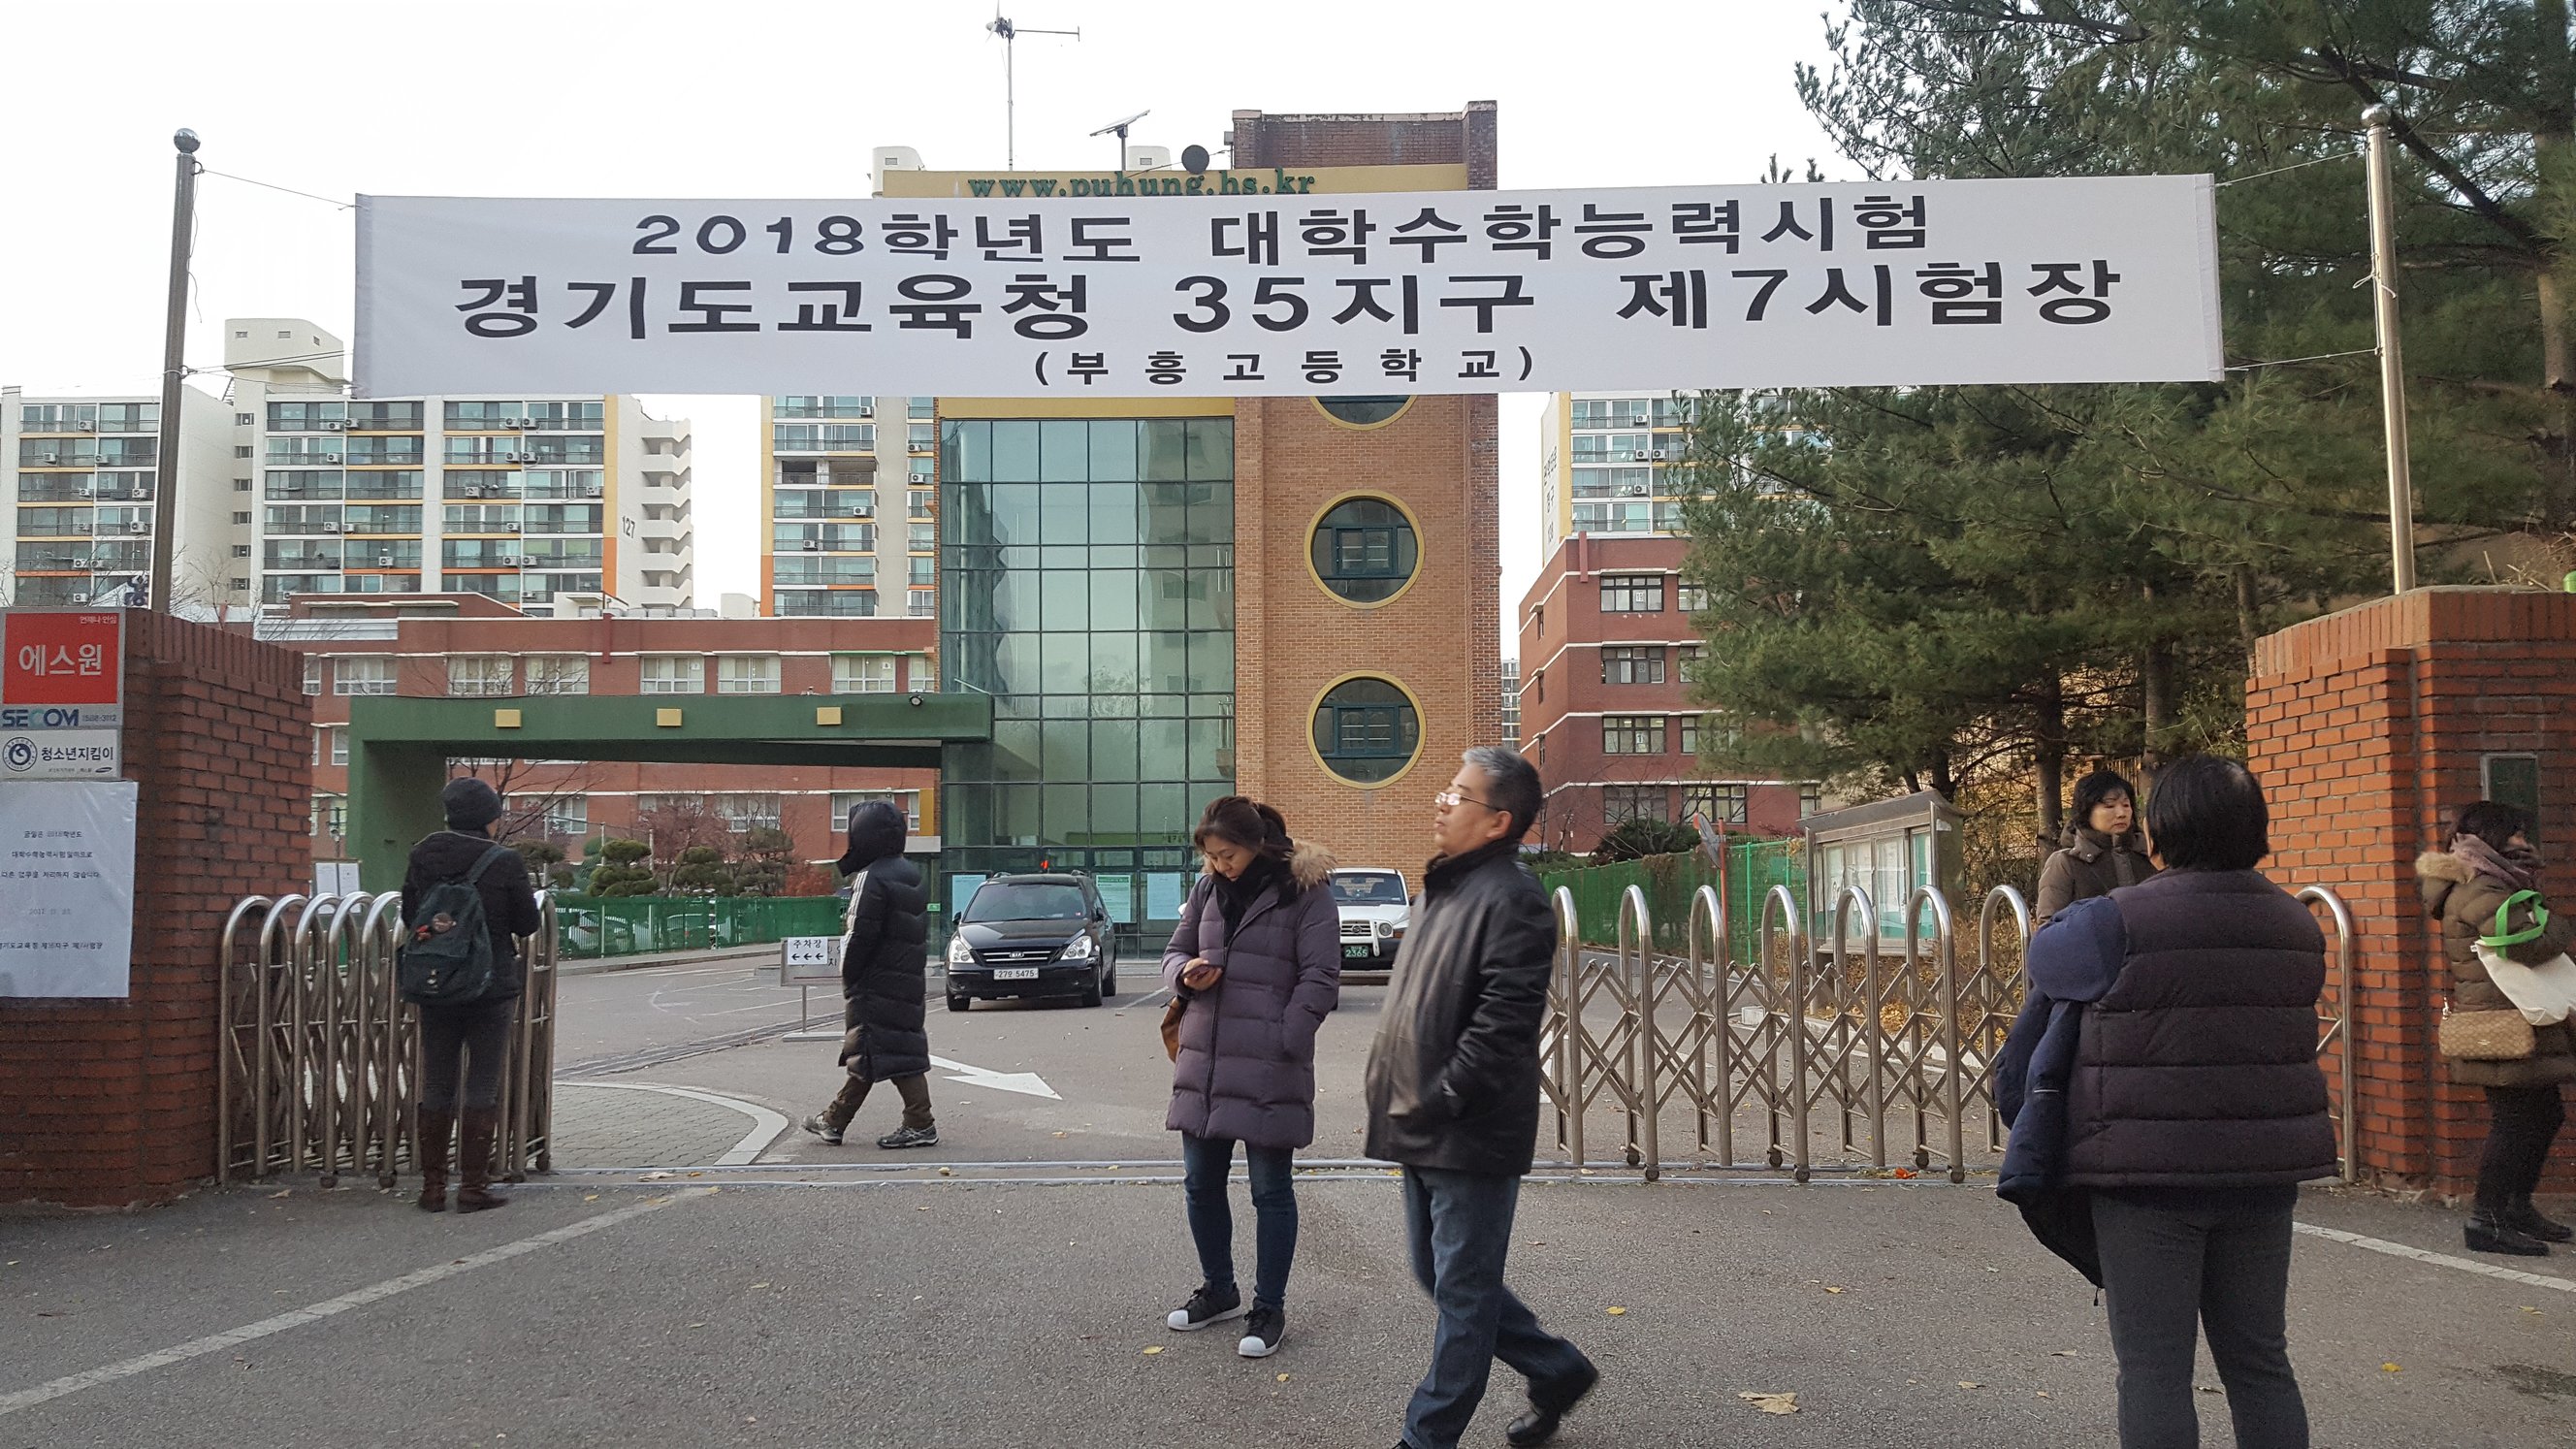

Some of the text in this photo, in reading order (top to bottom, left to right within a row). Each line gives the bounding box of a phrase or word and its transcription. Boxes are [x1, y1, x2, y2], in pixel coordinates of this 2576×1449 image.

[968, 168, 1315, 197] www.puhung.hs.kr
[632, 195, 1927, 266] 2018학년도 대학수학능력시험
[455, 258, 2121, 340] 경기도교육청 35지구 제7시험장
[622, 515, 636, 539] 127
[18, 643, 103, 677] 에스원
[2, 708, 80, 727] SECOM
[41, 746, 114, 762] 청소년지킴이
[793, 939, 821, 950] 주차장
[1345, 949, 1368, 958] 2365
